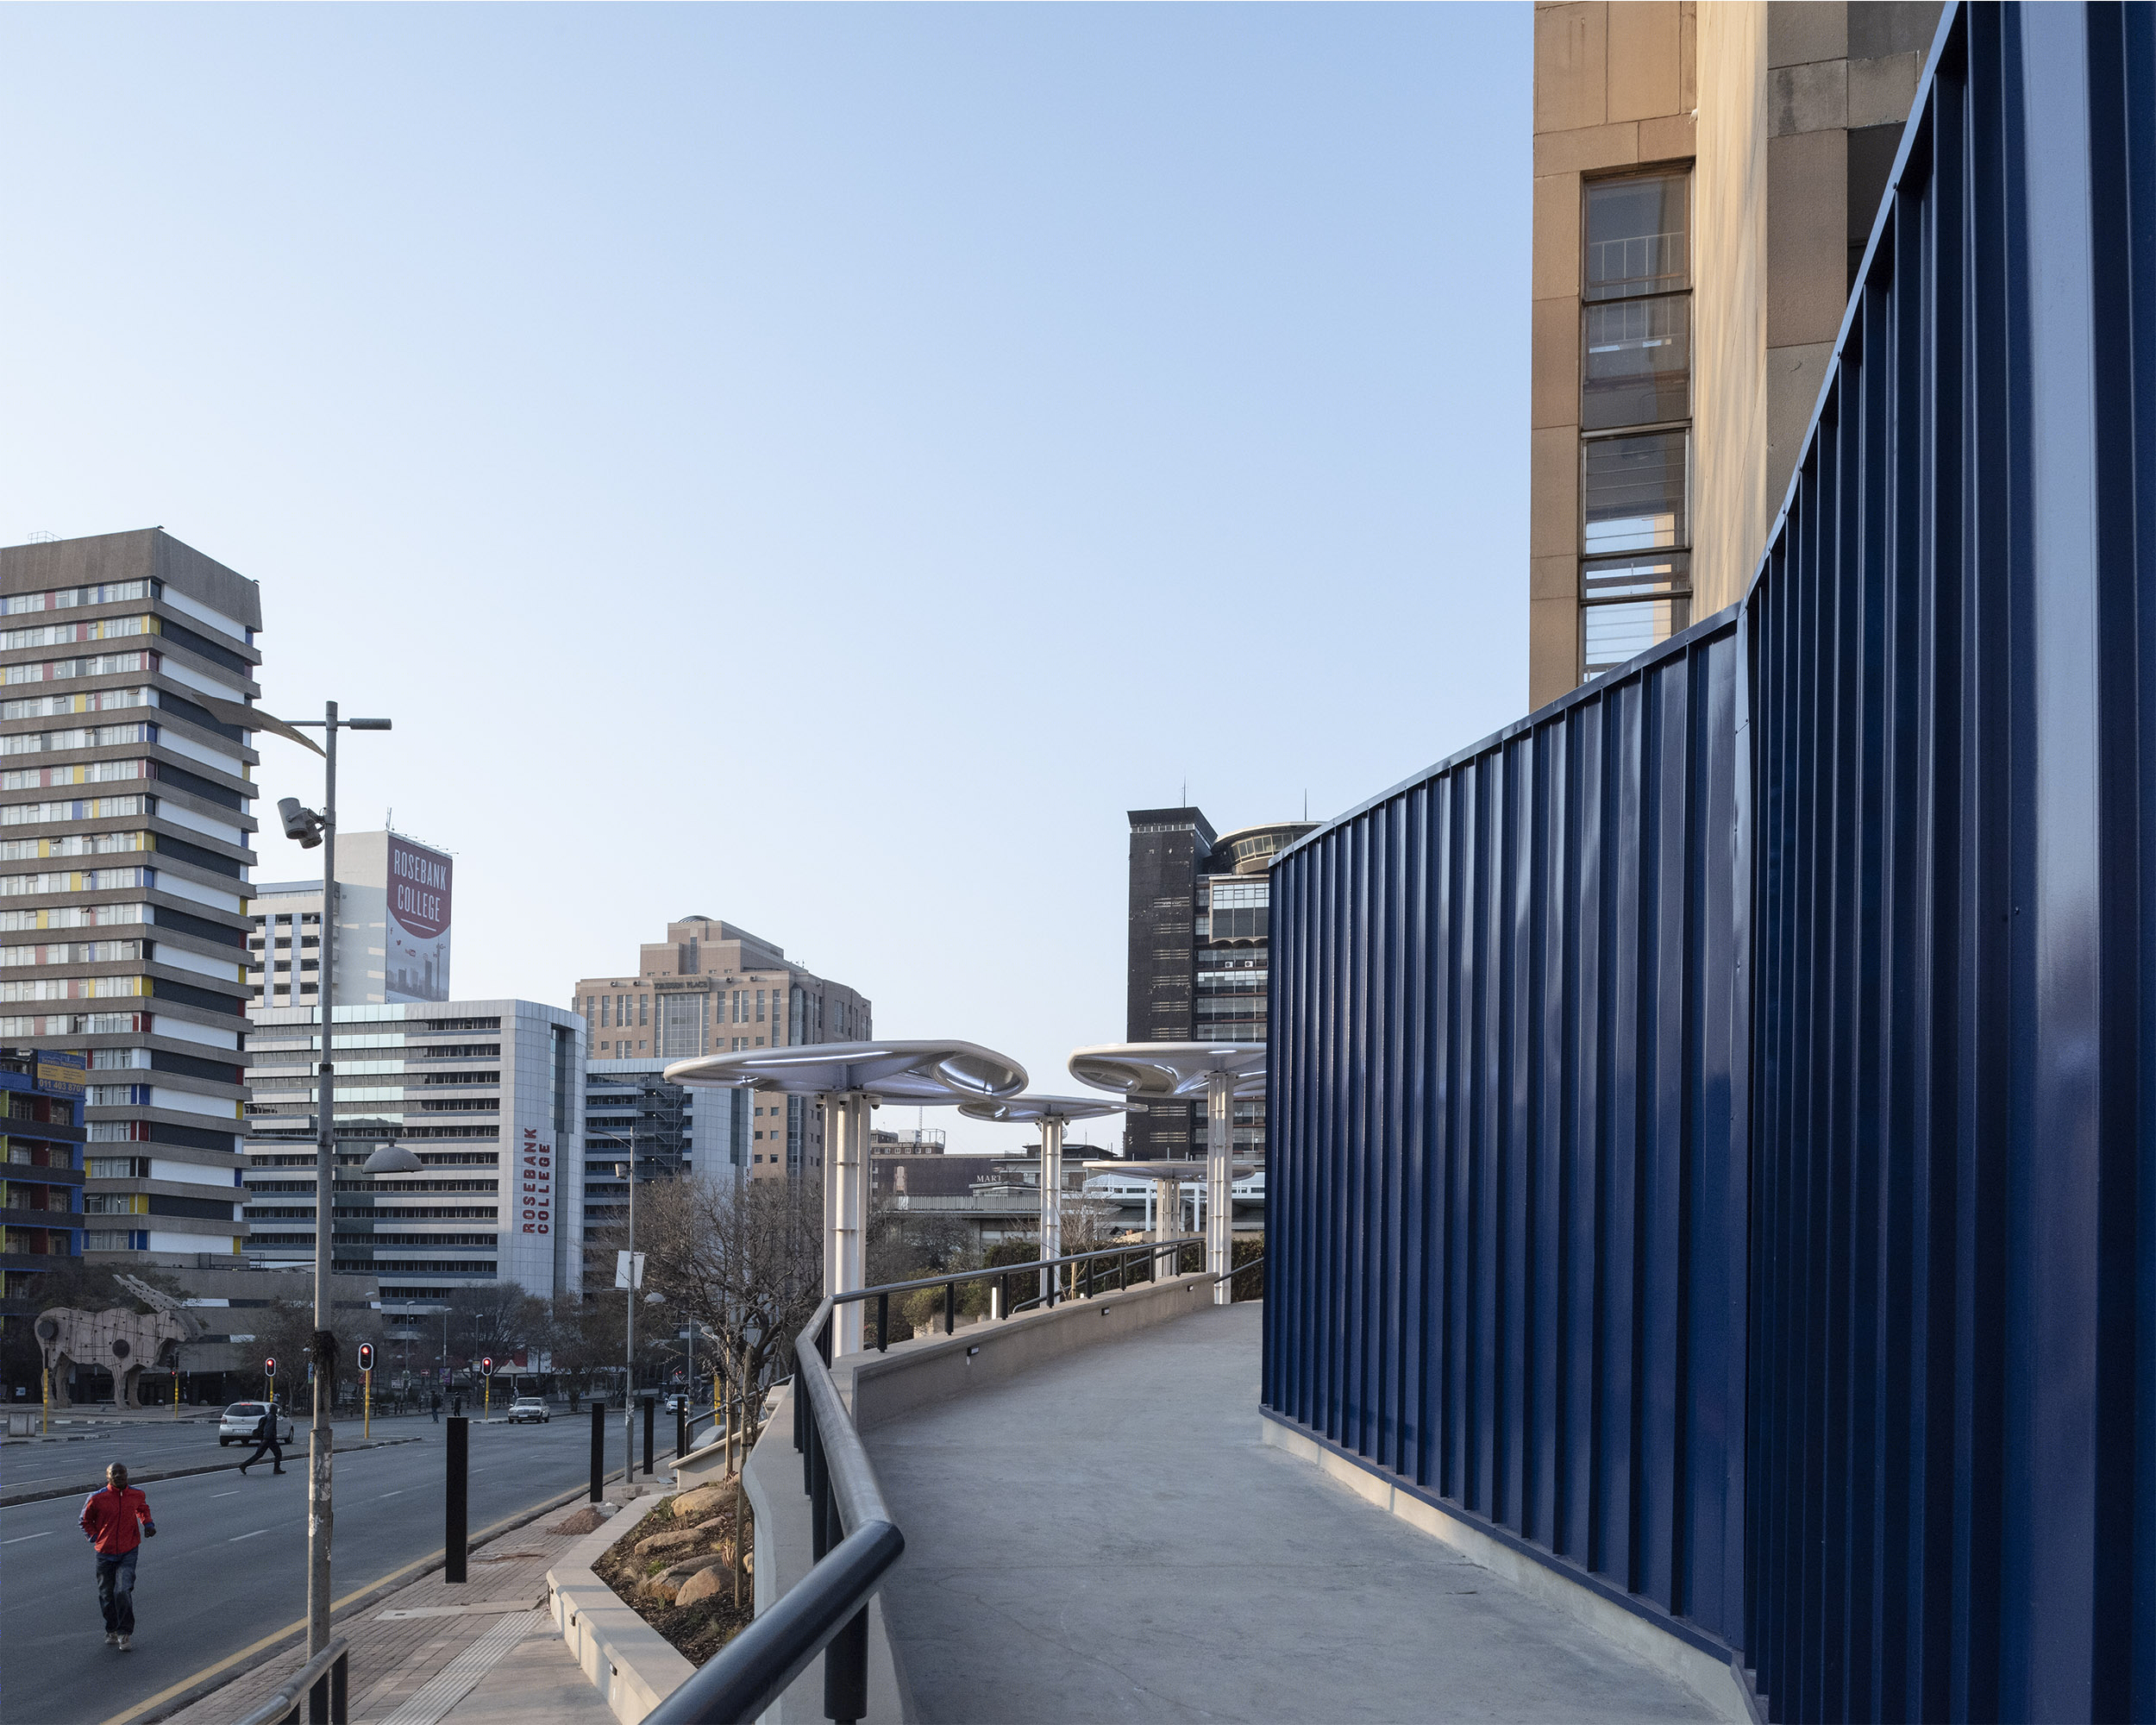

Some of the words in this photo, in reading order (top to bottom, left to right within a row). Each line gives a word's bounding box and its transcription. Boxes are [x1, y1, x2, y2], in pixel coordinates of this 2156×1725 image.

[394, 849, 447, 891] ROSEBANK
[398, 884, 441, 922] COLLEGE
[39, 1079, 52, 1088] 011
[53, 1082, 66, 1090] 403
[68, 1083, 85, 1093] 8707
[523, 1127, 537, 1233] ROSEBANK
[537, 1144, 550, 1234] COLLEGE
